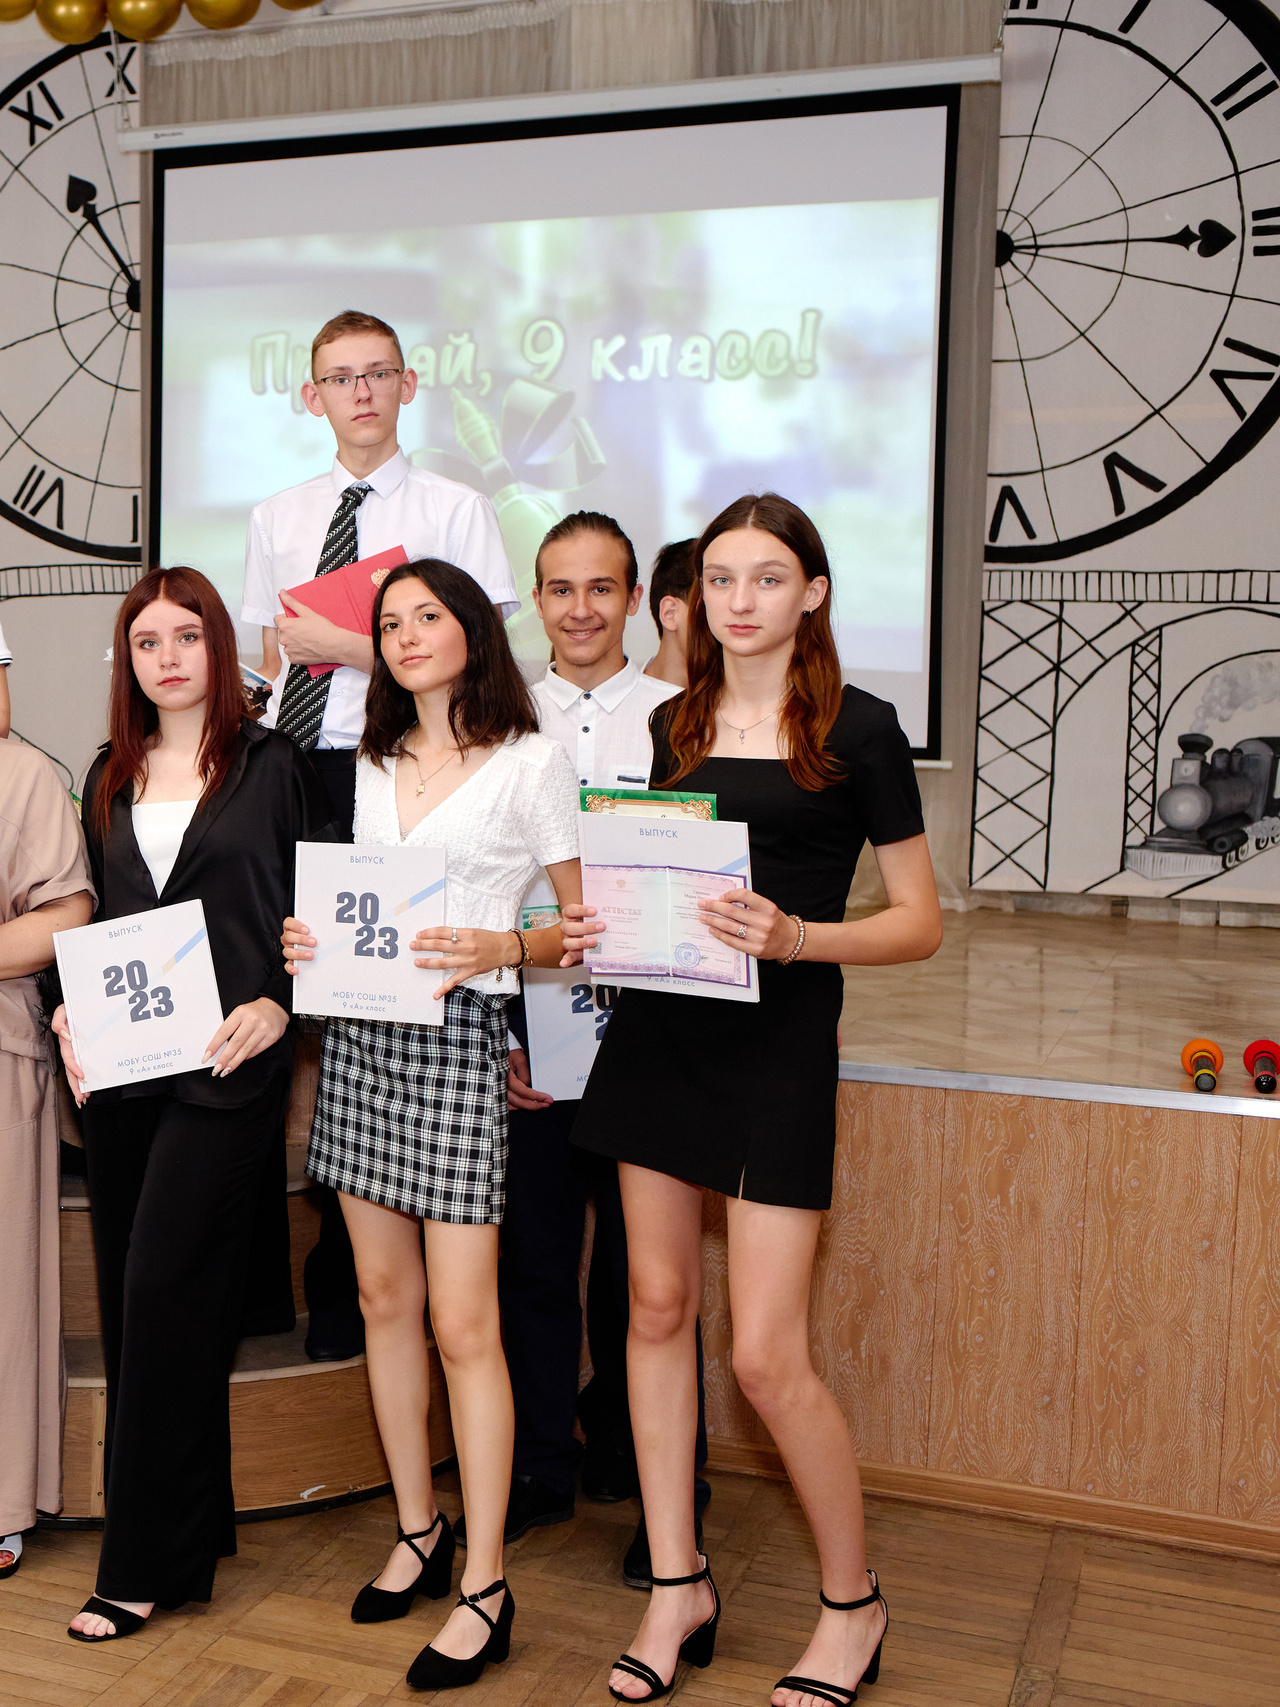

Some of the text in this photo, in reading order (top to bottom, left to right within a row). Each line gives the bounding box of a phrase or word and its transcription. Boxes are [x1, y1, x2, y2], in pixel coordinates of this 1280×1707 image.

[8, 81, 64, 146] XI
[249, 308, 822, 414] Прай, 9 класс!
[1103, 450, 1167, 517] V
[12, 464, 64, 531] VII
[639, 828, 678, 838] ВЫПУСК
[350, 855, 385, 864] ВЫПУСК
[335, 891, 380, 925] 20
[601, 906, 643, 916] АТТЕСТАТ
[108, 924, 143, 939] ВЫПУСК
[354, 924, 399, 959] 23
[102, 959, 149, 998] 20
[673, 979, 695, 987] класс
[128, 985, 175, 1022] 23
[332, 990, 397, 1003] МОБУ СОШ №35
[365, 1004, 386, 1012] класс
[595, 1010, 613, 1041] 2
[117, 1048, 182, 1068] МОБУ СОШ №35
[129, 1067, 134, 1075] 9
[153, 1061, 173, 1071] класс
